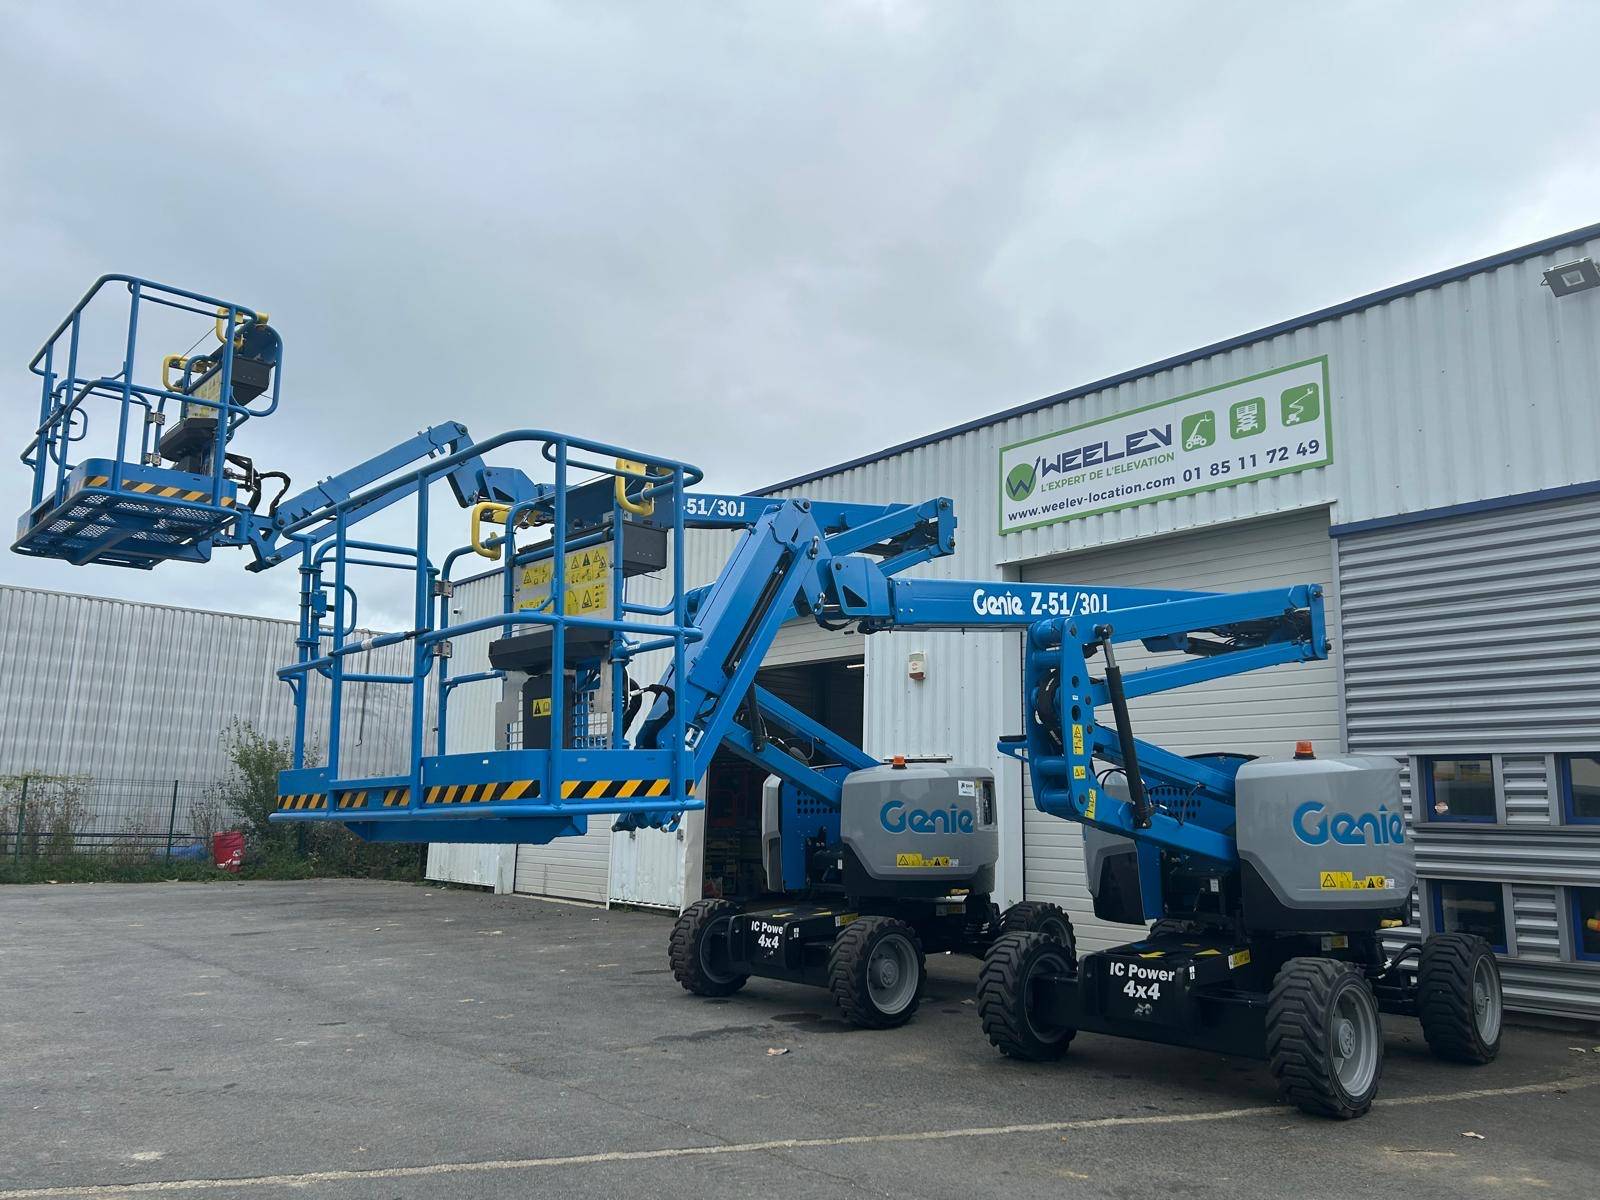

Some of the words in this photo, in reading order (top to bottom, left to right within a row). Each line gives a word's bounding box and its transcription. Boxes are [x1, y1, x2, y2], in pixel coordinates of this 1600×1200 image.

[1042, 424, 1172, 477] WEELEV
[1008, 476, 1175, 521] www.weelev-location.com
[1183, 466, 1201, 482] 01
[1210, 460, 1231, 476] 85
[1238, 453, 1257, 469] 11
[1266, 446, 1289, 464] 72
[1296, 439, 1320, 456] 49
[1041, 474, 1086, 492] L'EXPERT
[1089, 469, 1103, 481] DE
[1106, 452, 1175, 477] L'ELEVATION
[683, 498, 745, 517] -51/30J
[973, 588, 1025, 616] Genie
[1030, 591, 1108, 617] Z-51/30J
[879, 800, 974, 834] Genie
[1291, 800, 1405, 847] Genie
[751, 920, 761, 931] IC
[761, 921, 784, 935] Powe
[757, 933, 780, 949] 4x4
[1109, 962, 1125, 977] IC
[1128, 963, 1175, 982] Power
[1123, 980, 1161, 1000] 4x4
